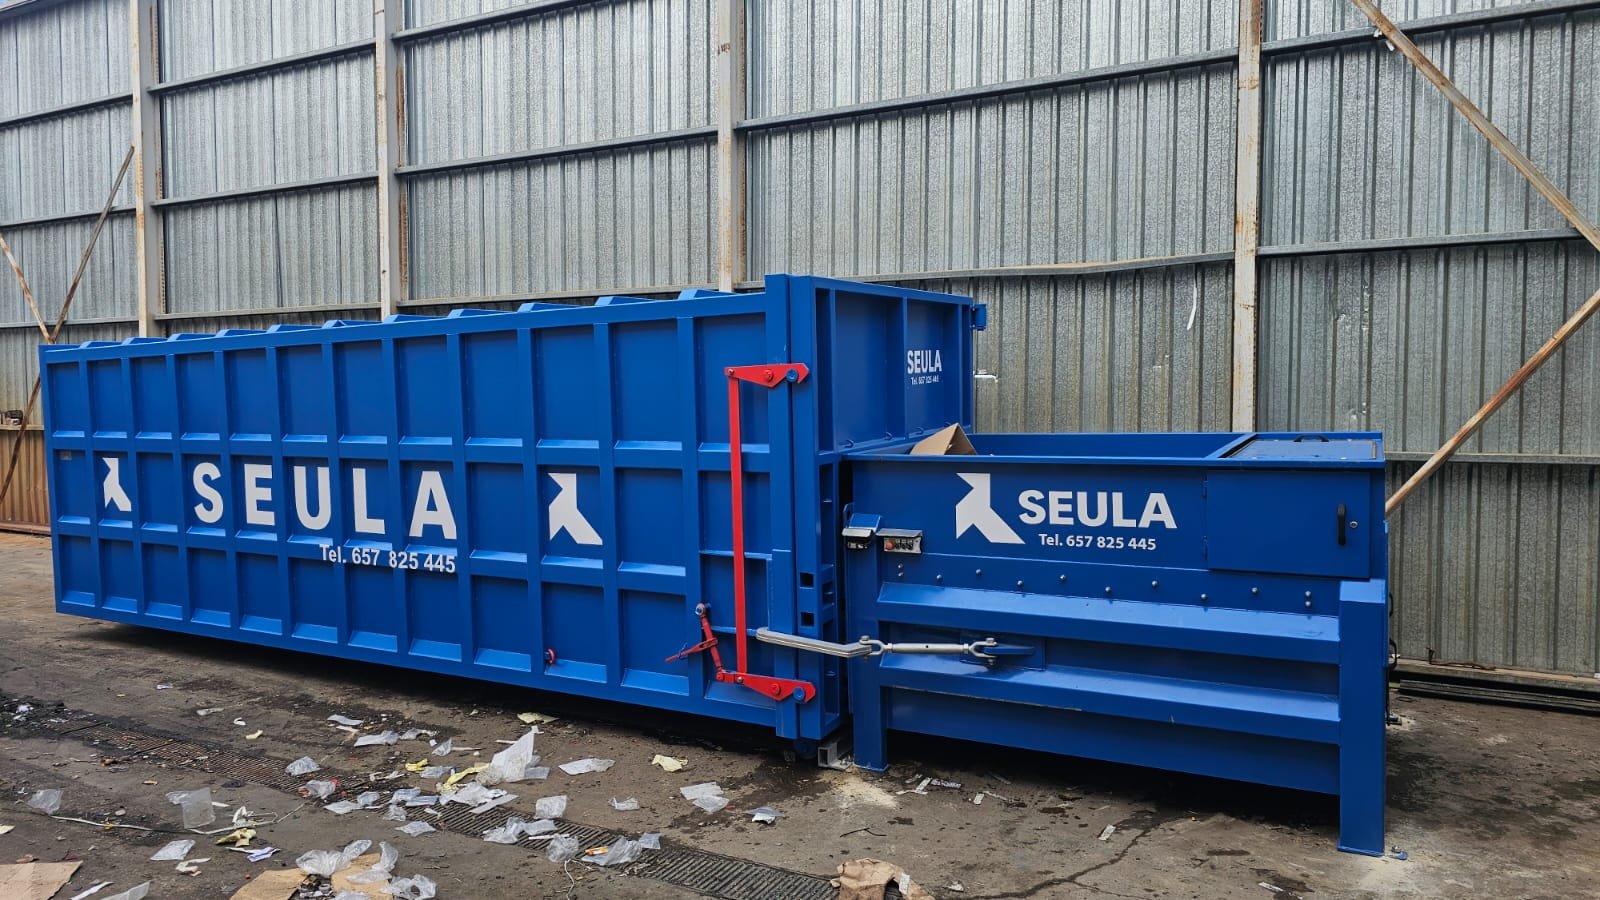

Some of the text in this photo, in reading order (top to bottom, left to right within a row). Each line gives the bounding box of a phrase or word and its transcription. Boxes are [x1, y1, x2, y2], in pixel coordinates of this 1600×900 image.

[907, 350, 942, 374] SEULA
[192, 462, 457, 540] SEULA
[1018, 489, 1178, 529] SEULA
[1038, 533, 1156, 550] Tel. 657 825 445
[319, 544, 456, 573] Tel. 657 825 445
